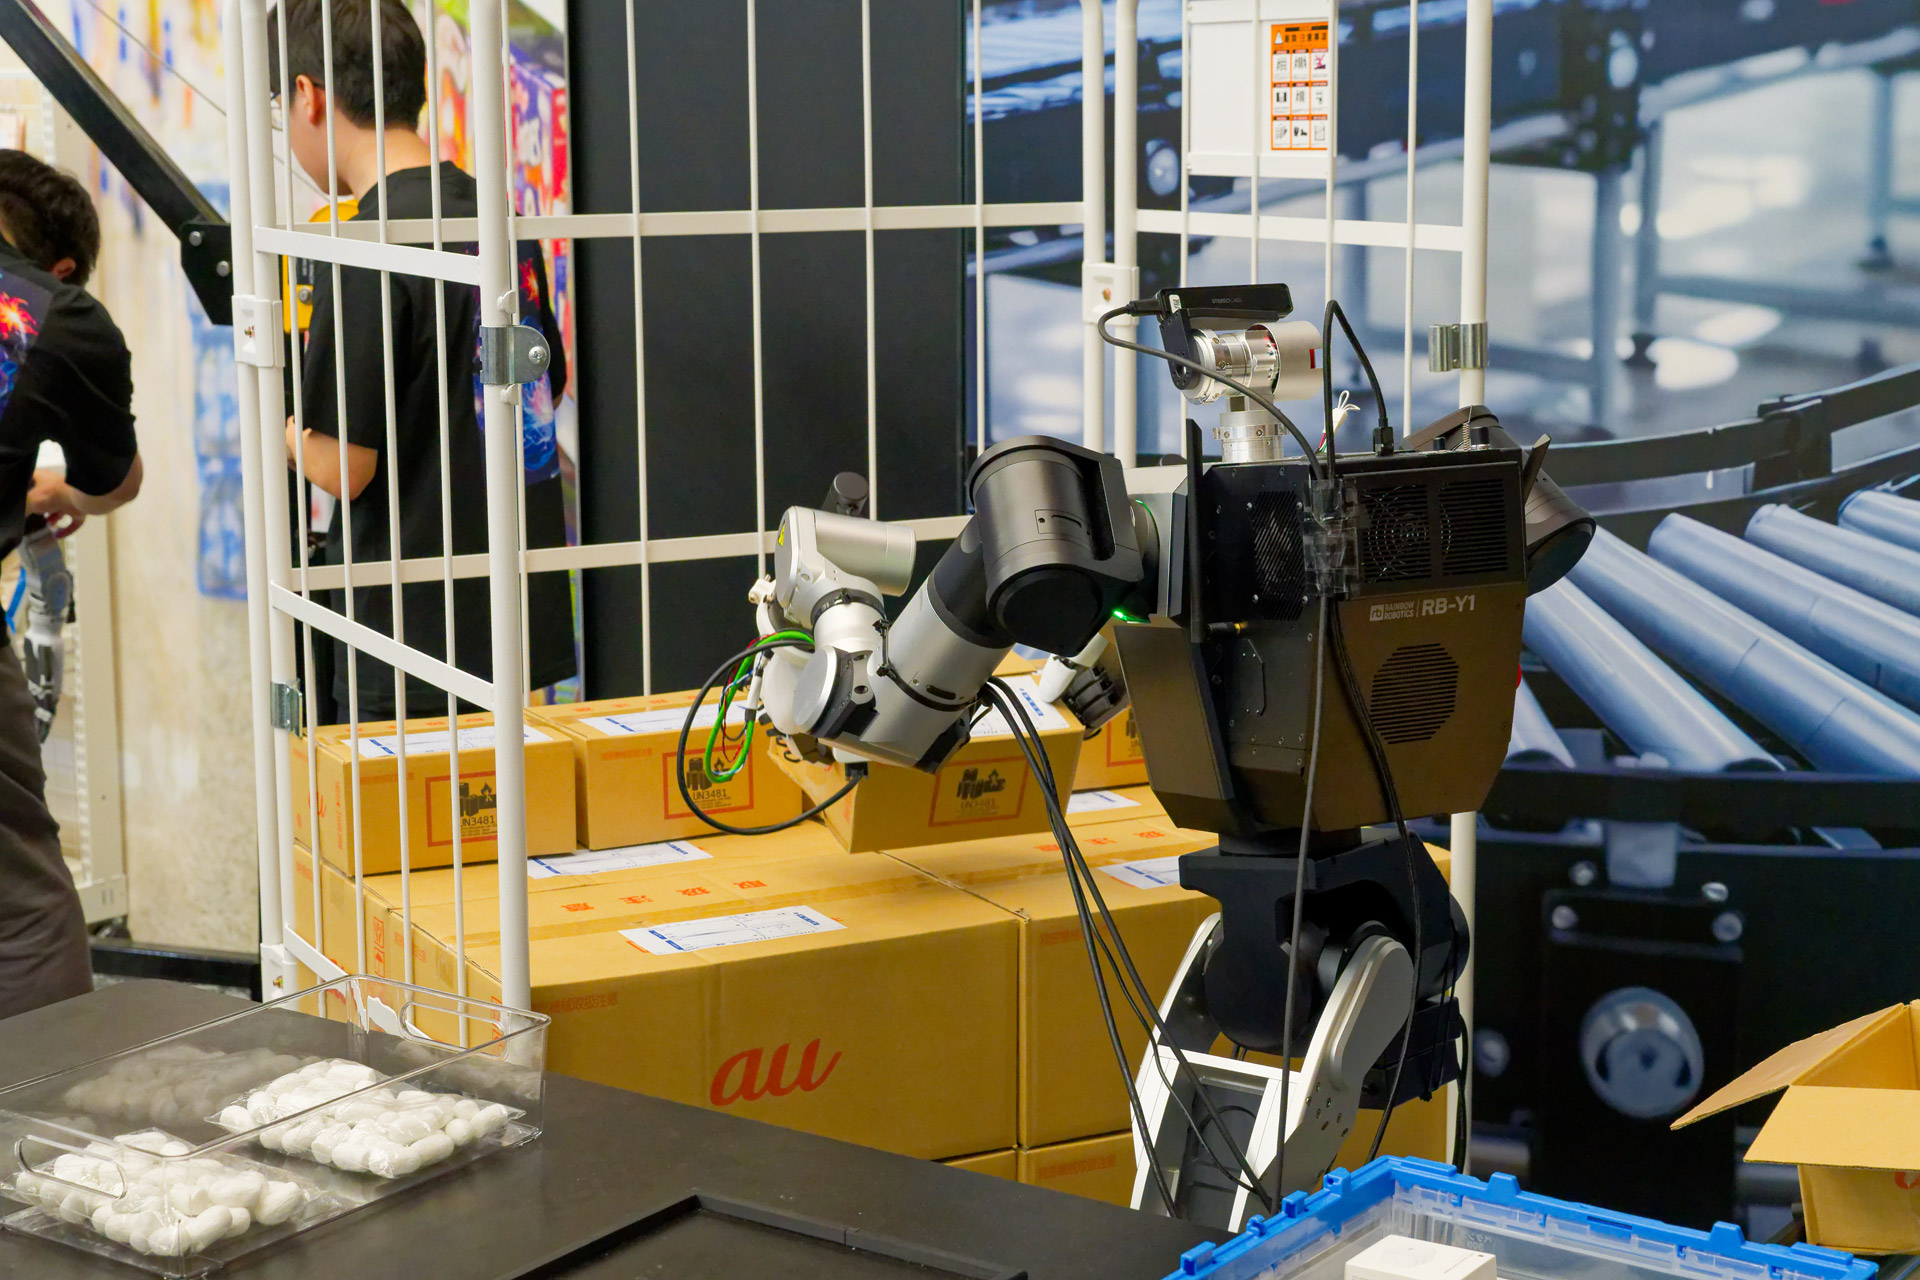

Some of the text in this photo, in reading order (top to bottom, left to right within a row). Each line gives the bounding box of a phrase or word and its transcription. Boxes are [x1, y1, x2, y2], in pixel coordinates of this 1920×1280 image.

[1385, 601, 1415, 611] RAINBOW
[1422, 595, 1476, 616] RB-Y1
[1384, 609, 1415, 620] ROBOTICS
[691, 789, 728, 801] UN3481
[709, 1038, 843, 1107] au
